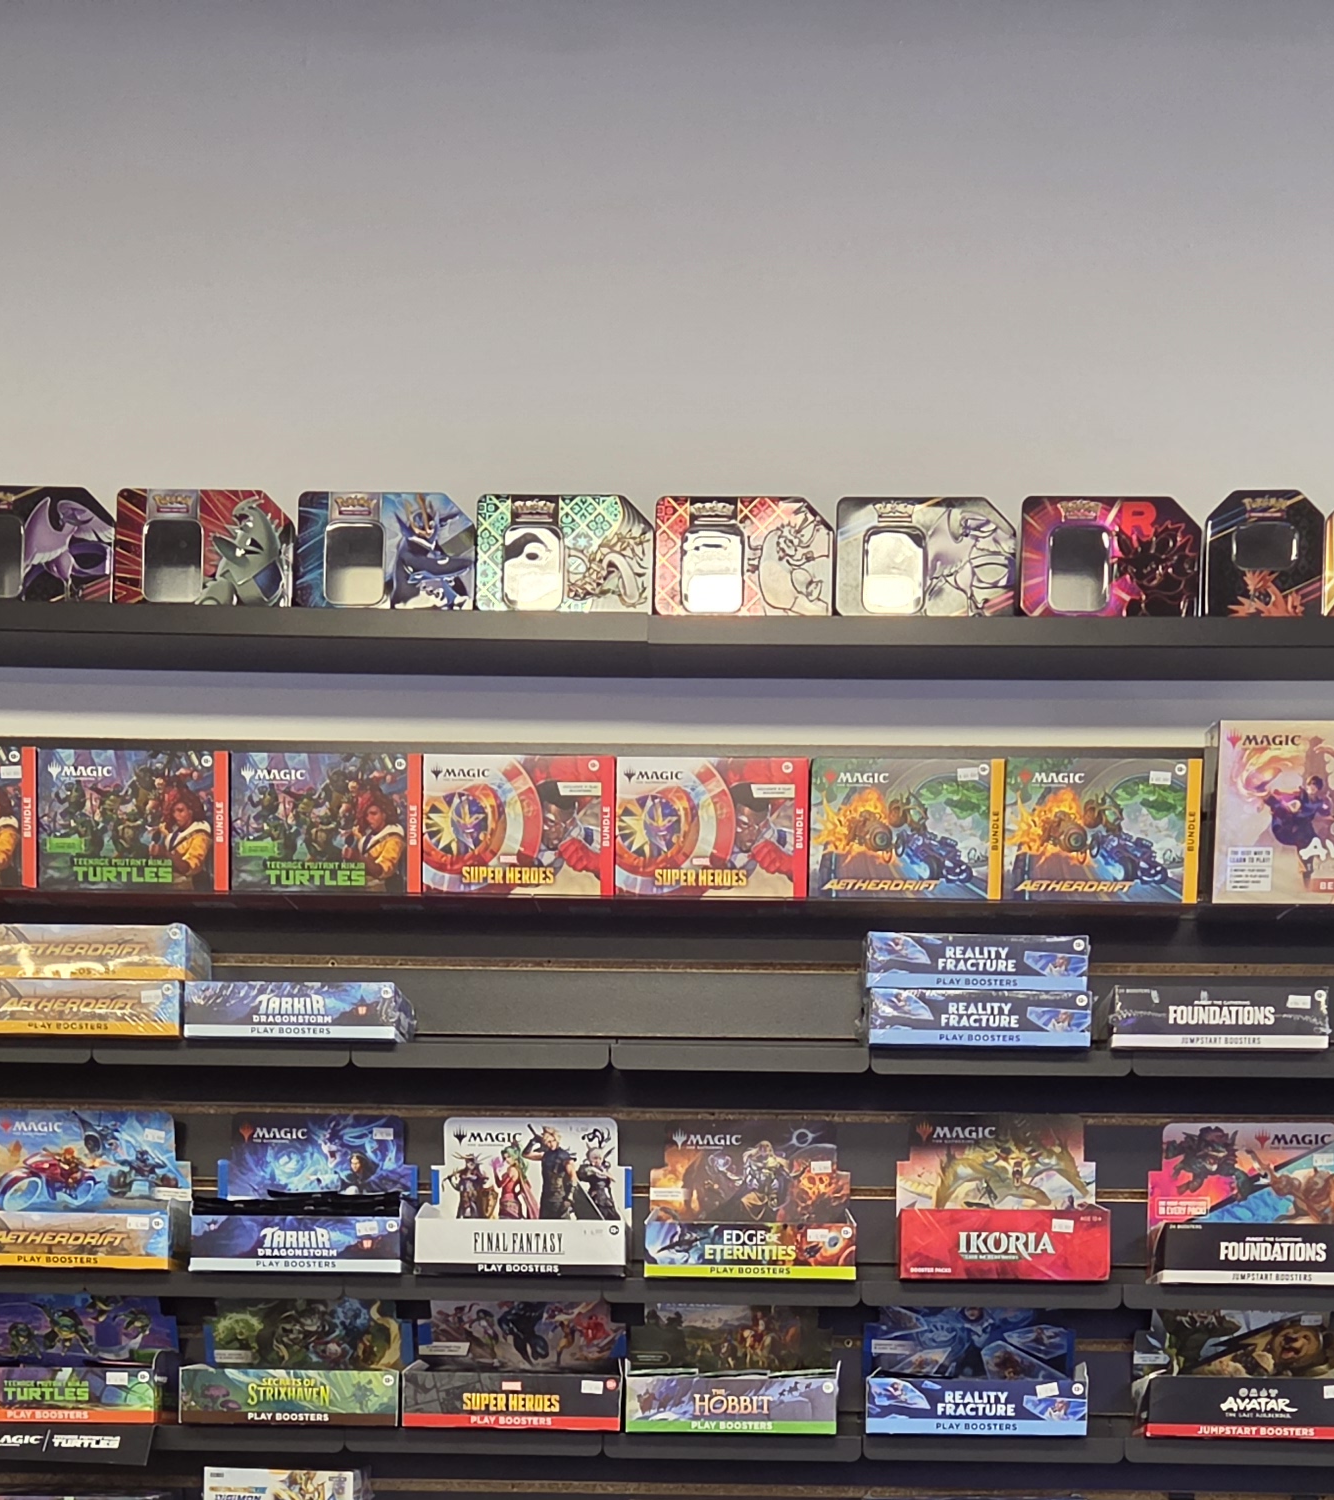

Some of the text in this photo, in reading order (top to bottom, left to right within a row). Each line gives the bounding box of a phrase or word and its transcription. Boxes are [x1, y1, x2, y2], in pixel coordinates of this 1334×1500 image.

[1242, 734, 1301, 746] MAGIC
[945, 946, 1010, 960] REALITY
[937, 958, 1016, 972] FRACTURE
[255, 995, 326, 1014] TARKIR
[252, 1013, 333, 1024] DRAGONSTORM
[1169, 1005, 1275, 1025] FOUNDATIONS
[1180, 1036, 1262, 1045] JUMPSTART BOOSTERS
[473, 1231, 564, 1254] FINAL FANTASY
[723, 1229, 767, 1245] EDGE
[957, 1231, 1056, 1255] IKORIA
[704, 1245, 797, 1261] ETERNITIES
[261, 1378, 315, 1388] SECRETS OF
[247, 1383, 330, 1407] STRIXHAVEN
[693, 1394, 774, 1416] HOBBIT
